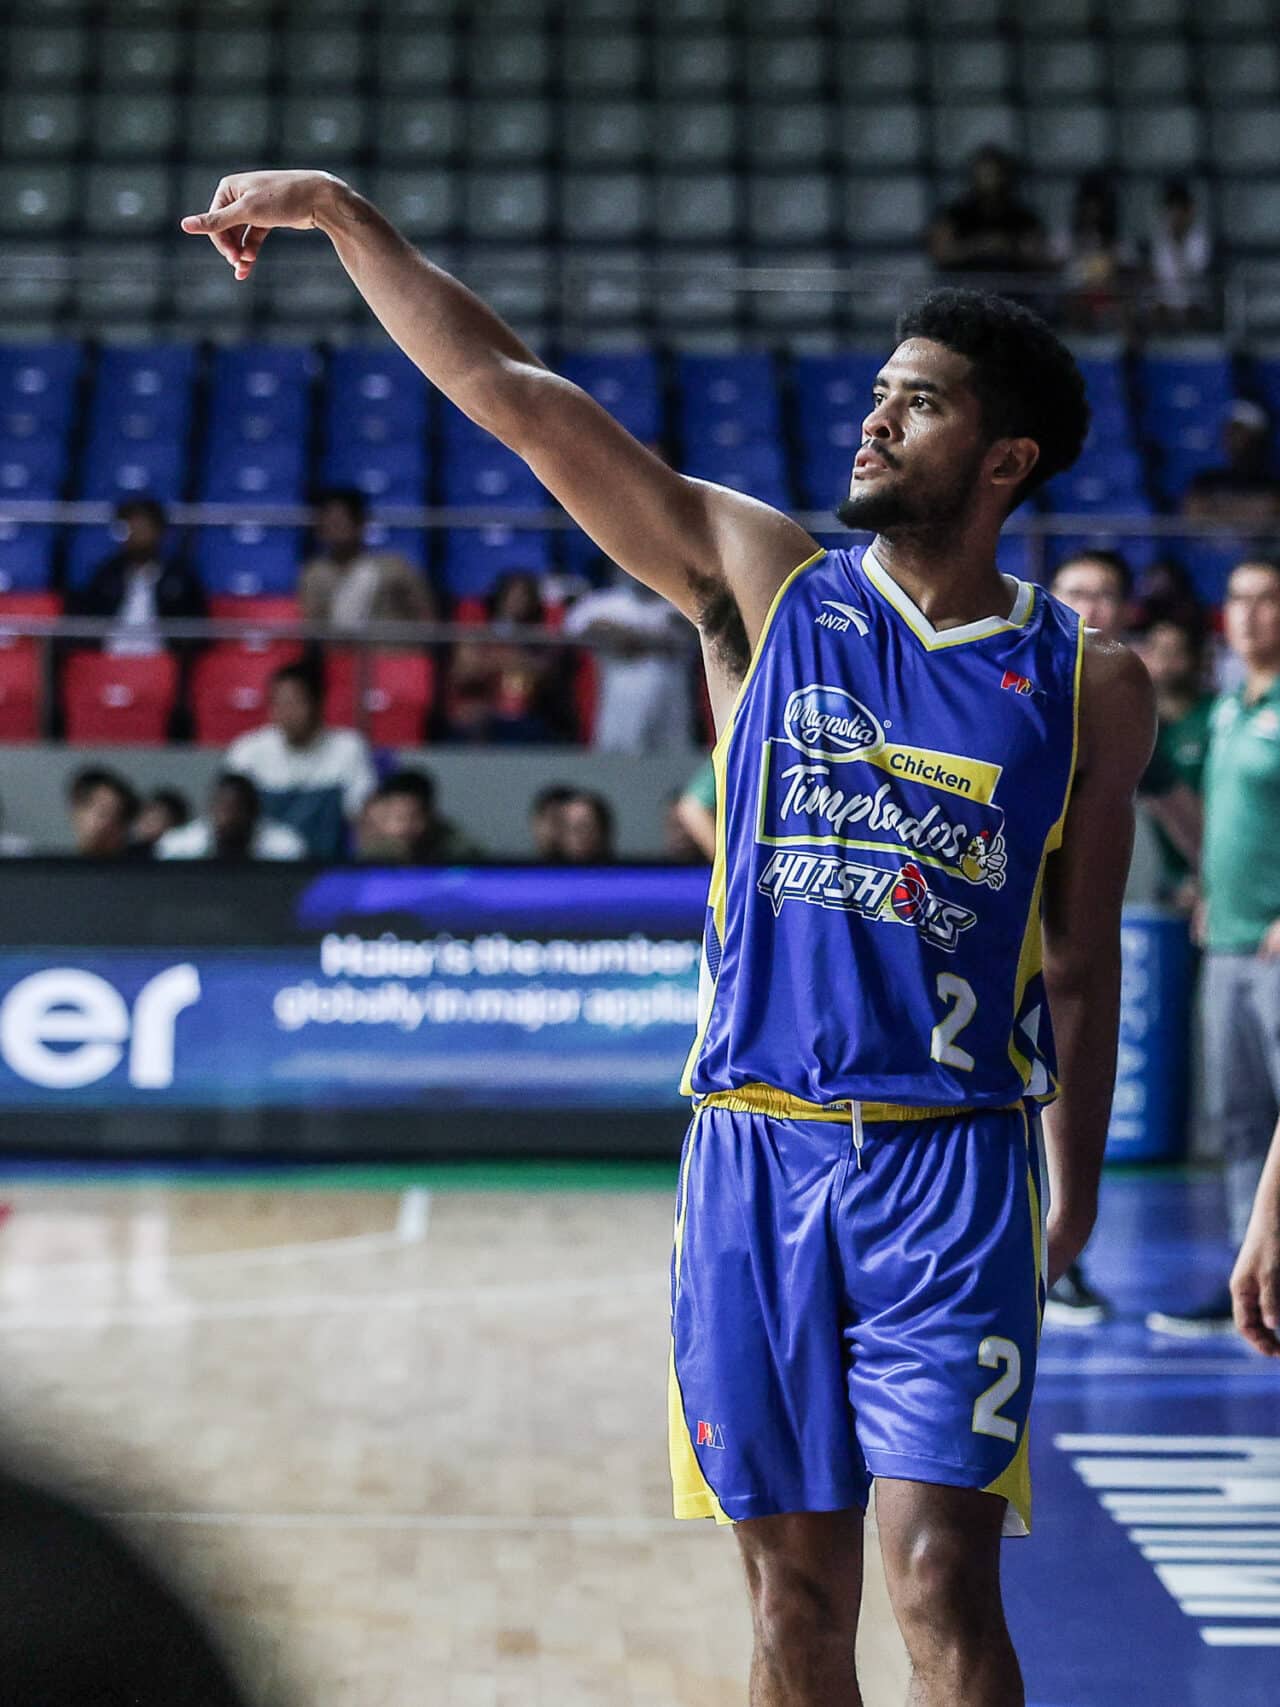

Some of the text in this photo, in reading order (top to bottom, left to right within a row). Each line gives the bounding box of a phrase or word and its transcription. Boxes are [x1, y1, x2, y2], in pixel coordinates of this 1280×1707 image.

[815, 611, 851, 634] ANTA
[786, 698, 875, 749] Magnolia
[889, 752, 972, 794] Chicken
[780, 764, 967, 859] Timplados
[930, 971, 978, 1072] 2
[971, 1335, 1022, 1444] 2
